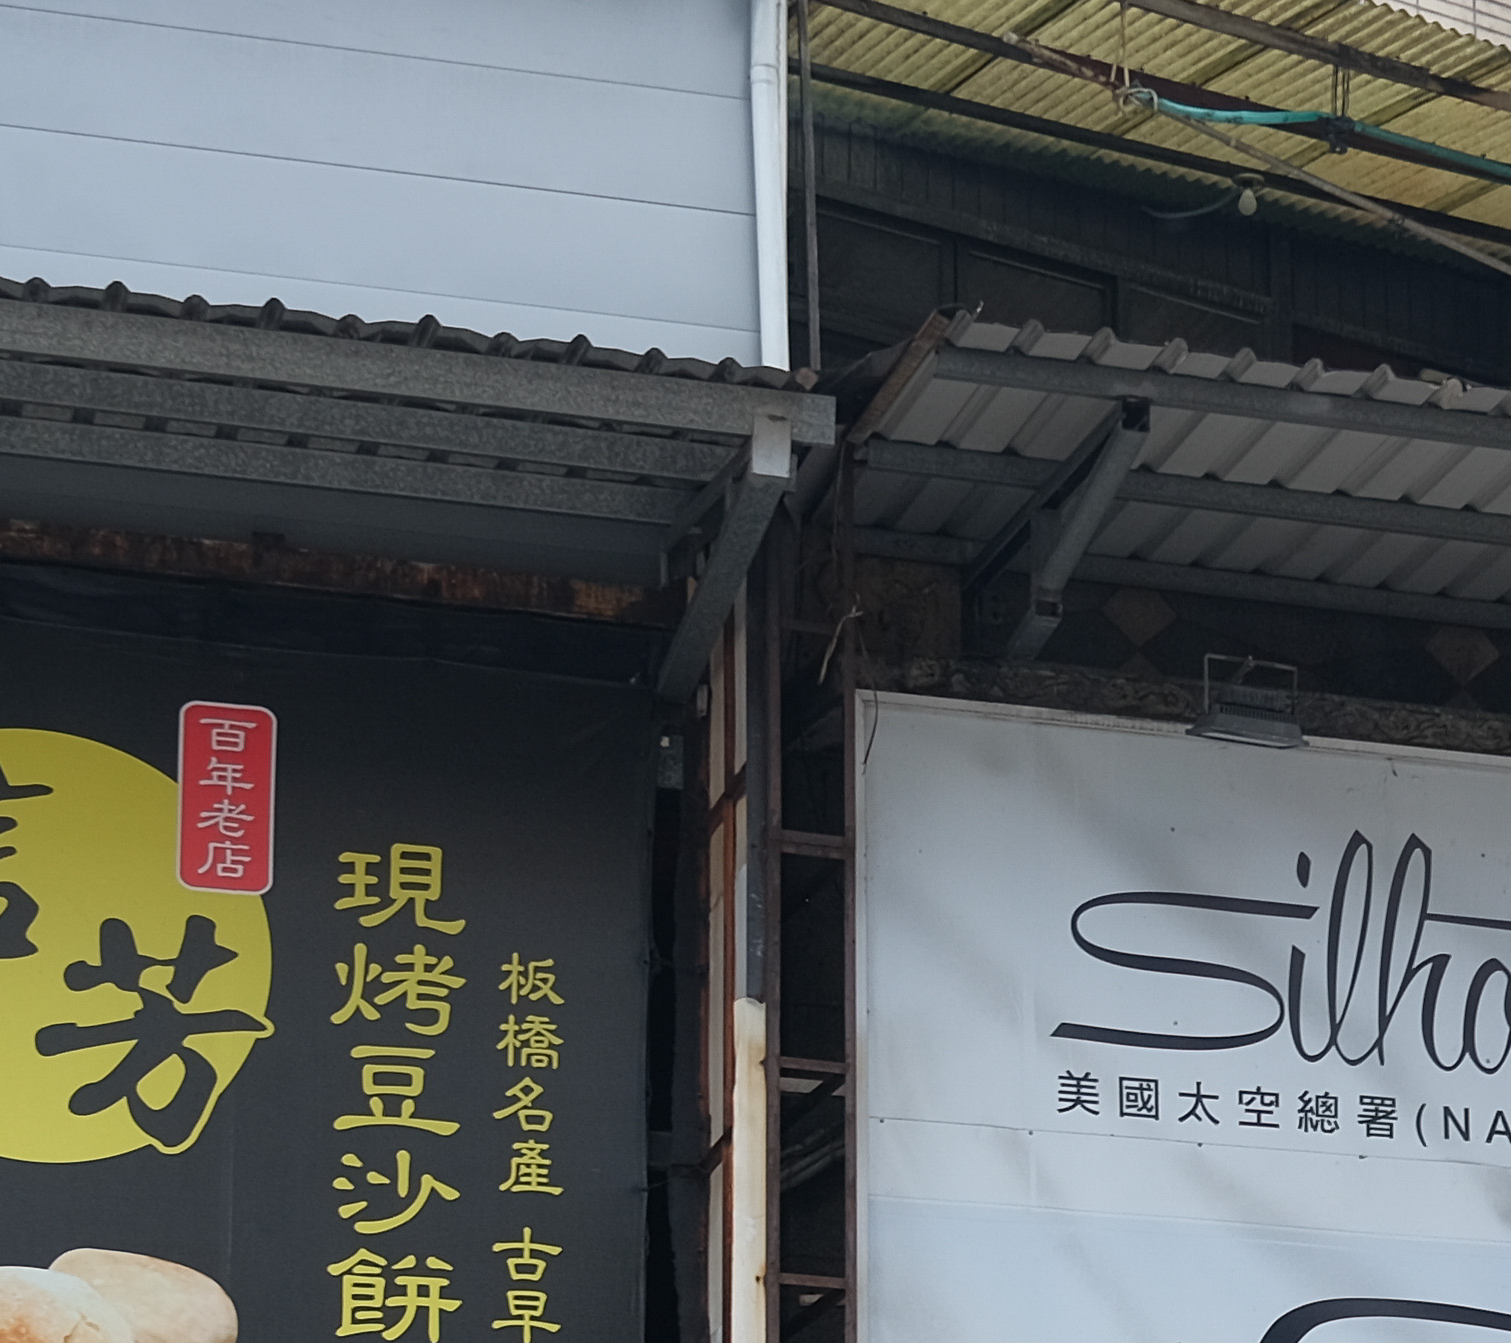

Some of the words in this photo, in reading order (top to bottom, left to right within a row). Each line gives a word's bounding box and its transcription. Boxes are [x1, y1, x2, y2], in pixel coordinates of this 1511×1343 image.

[198, 716, 256, 881] 百年老店
[492, 952, 564, 1197] 板橋名產
